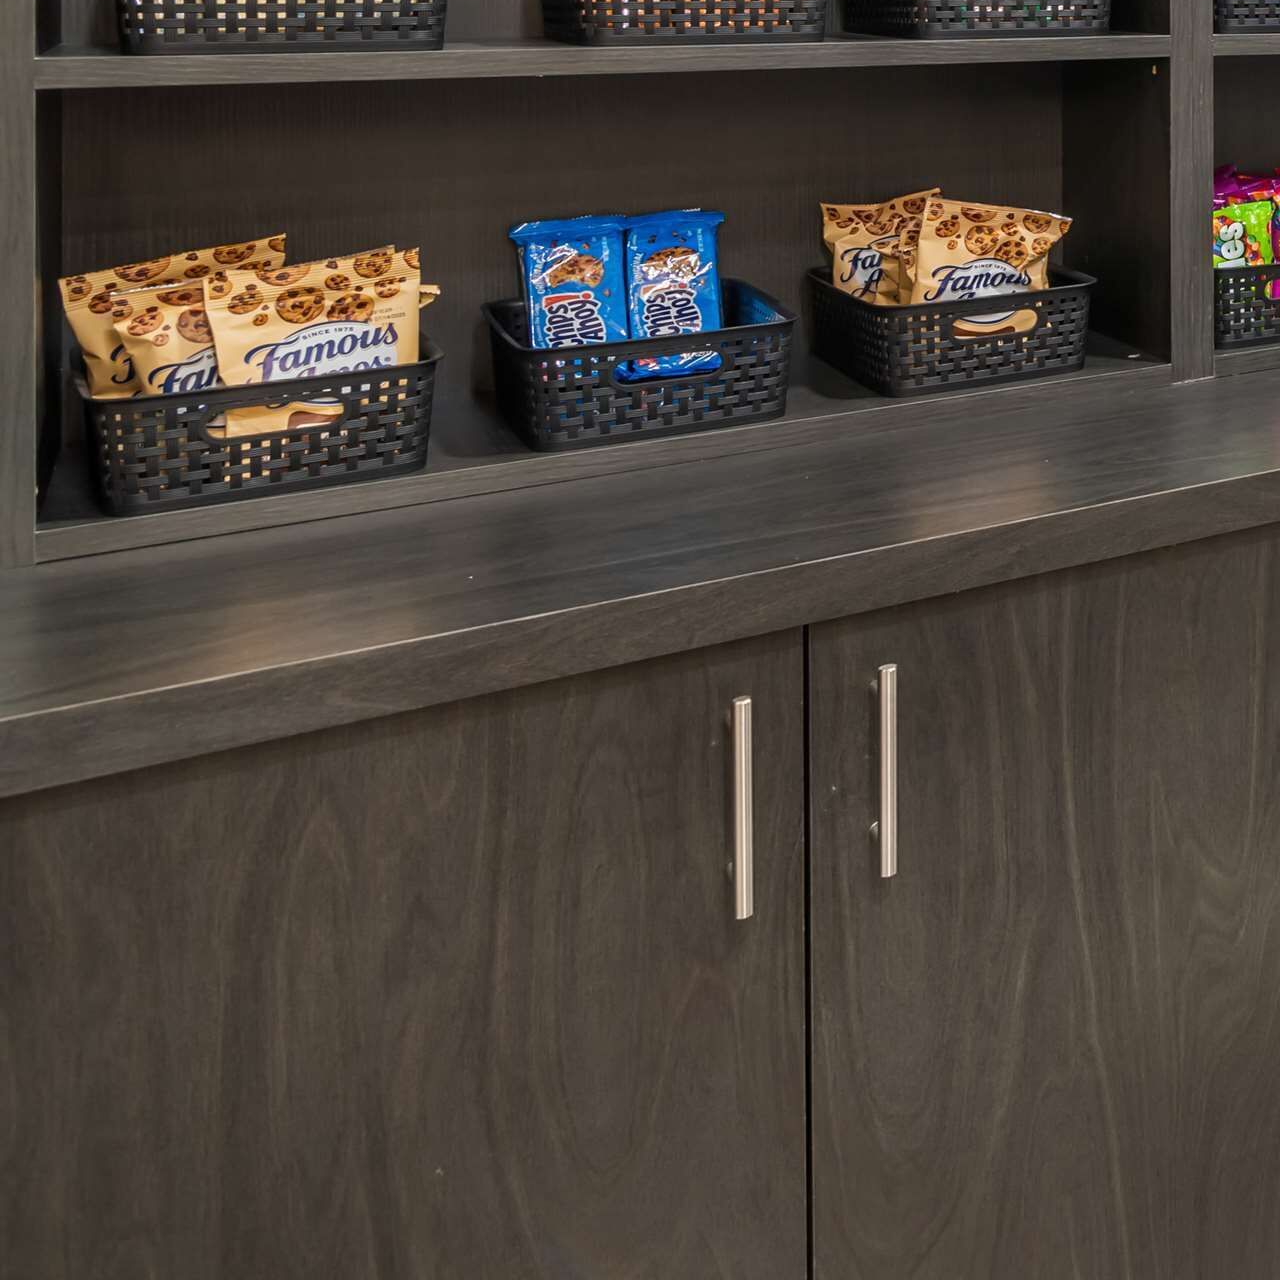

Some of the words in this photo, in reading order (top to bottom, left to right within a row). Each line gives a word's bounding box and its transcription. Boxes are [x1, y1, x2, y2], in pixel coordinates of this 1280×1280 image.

[924, 265, 1032, 302] Famous
[244, 322, 399, 382] Famous
[302, 330, 331, 340] SINCE
